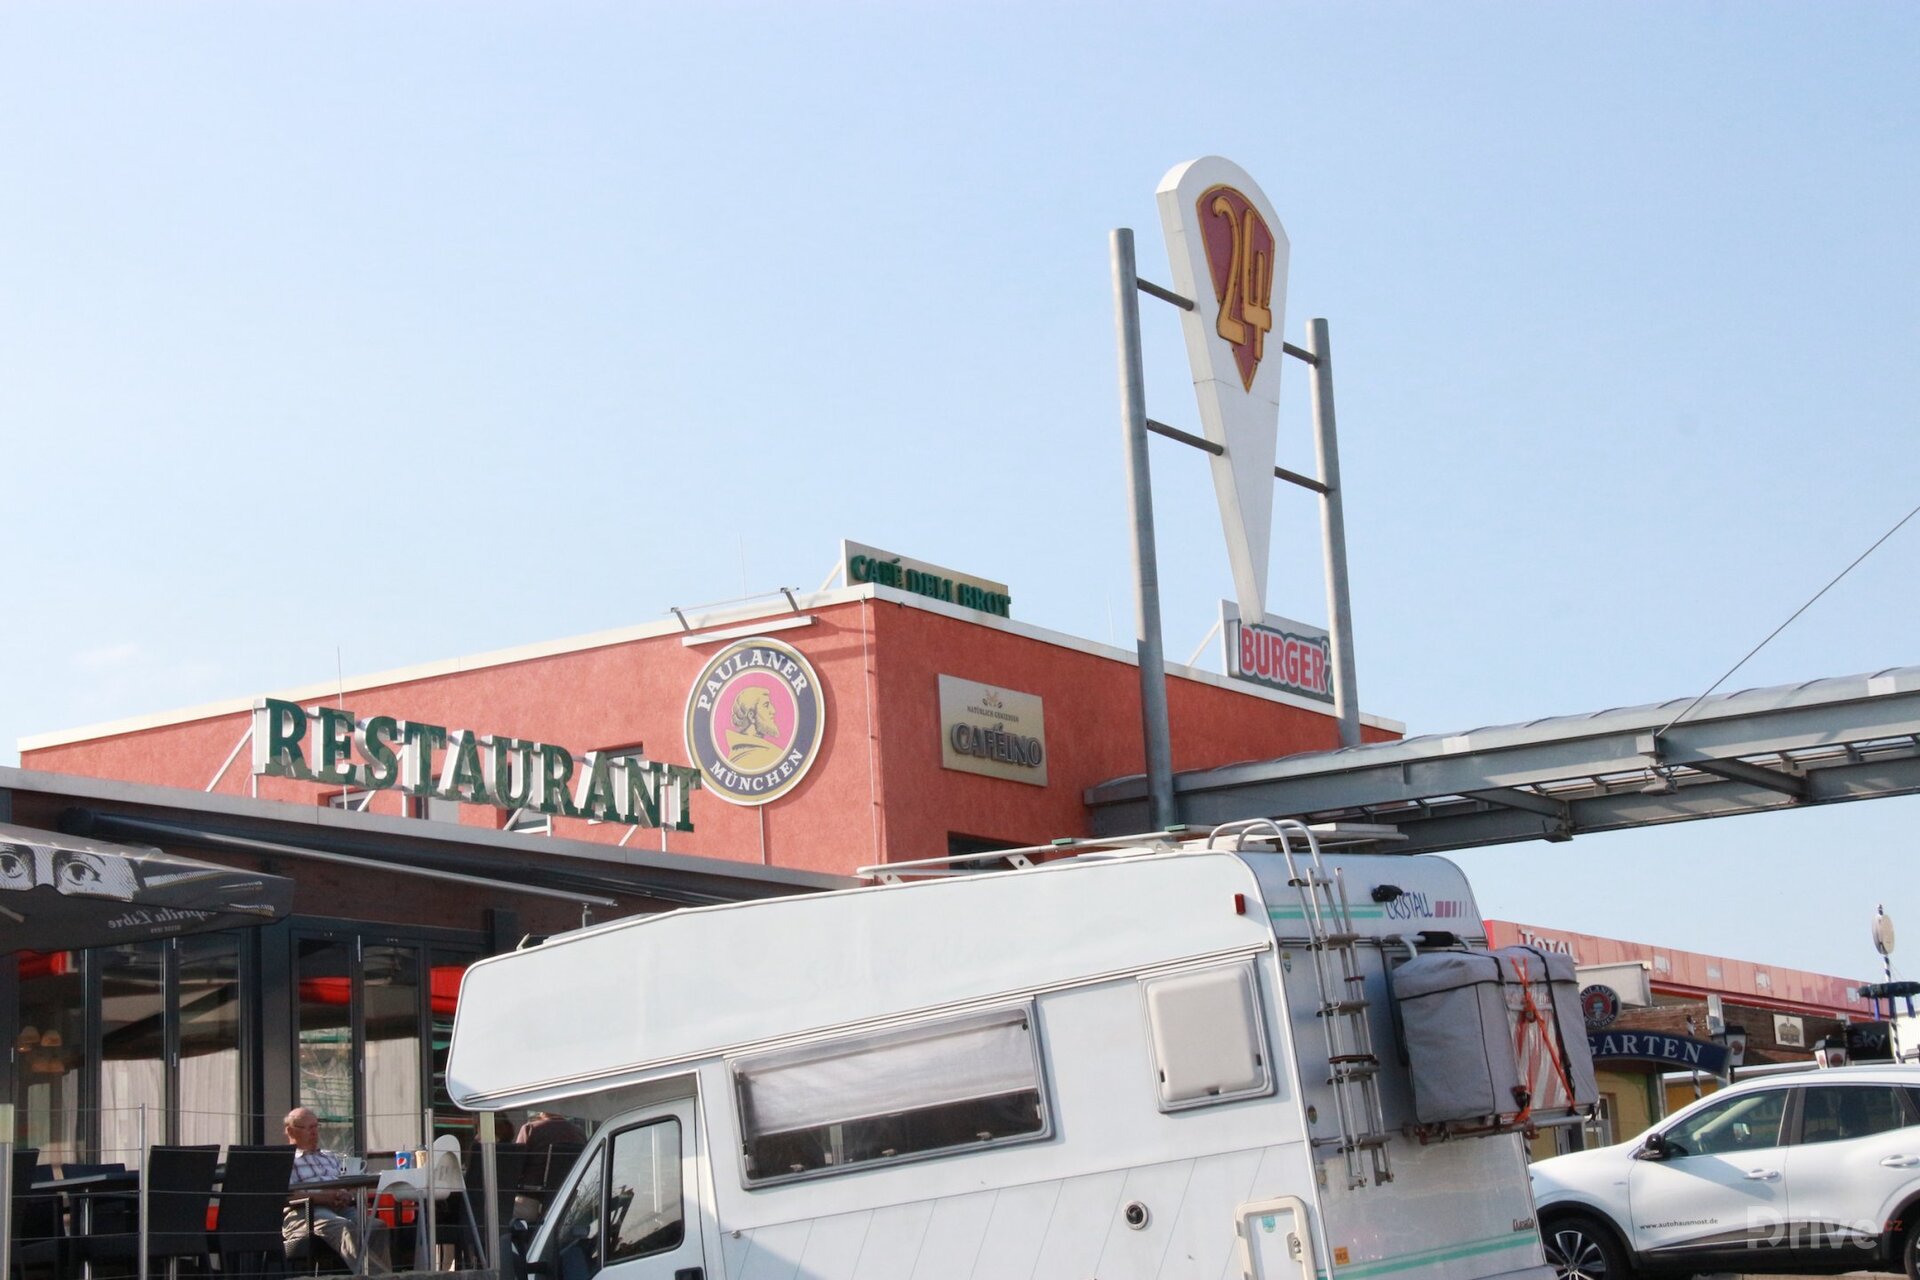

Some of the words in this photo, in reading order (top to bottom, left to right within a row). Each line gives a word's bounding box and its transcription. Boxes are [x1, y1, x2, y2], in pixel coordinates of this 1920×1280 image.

[906, 569, 953, 602] DELI
[957, 582, 1012, 619] BROT
[697, 649, 808, 711] PAULANER
[259, 697, 702, 833] RESTAURANT
[709, 749, 803, 791] MÜNCHEN
